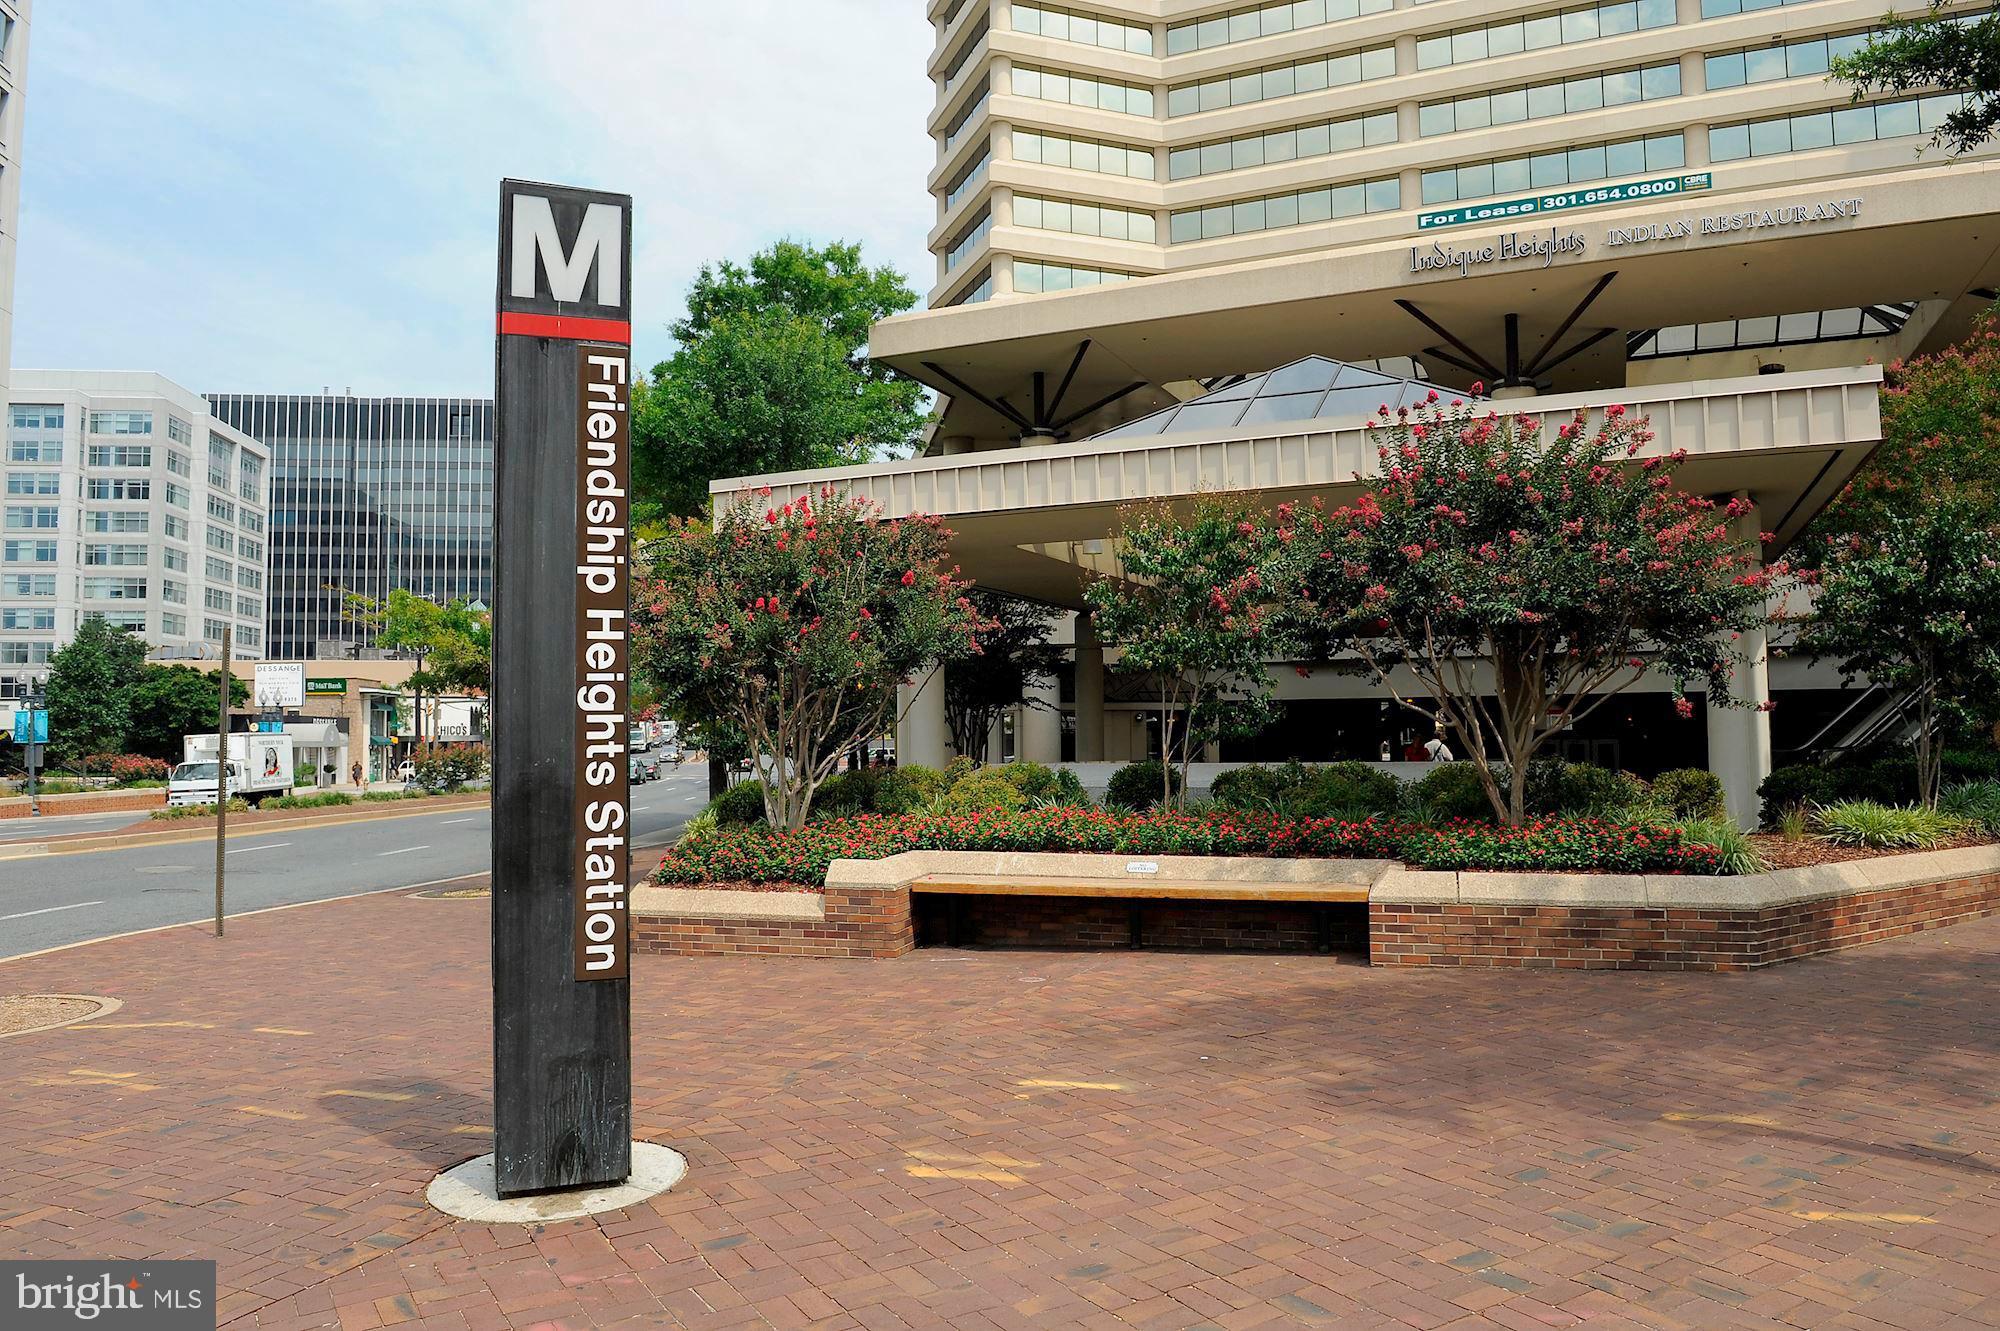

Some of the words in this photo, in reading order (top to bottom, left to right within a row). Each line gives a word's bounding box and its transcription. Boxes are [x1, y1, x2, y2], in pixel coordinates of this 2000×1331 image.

[1420, 213, 1457, 227] For
[1465, 202, 1535, 220] Lease
[1543, 180, 1677, 209] 301.654.0800
[1684, 174, 1708, 184] CBRE
[1607, 218, 1694, 246] INDIAN
[1700, 197, 1864, 235] RESTAURANT
[511, 194, 622, 307] M
[1409, 240, 1495, 277] Indique
[1498, 226, 1586, 268] Heights
[577, 355, 625, 594] Friendship
[577, 609, 625, 787] Heights
[437, 723, 467, 735] HICO'S
[584, 800, 625, 971] Station
